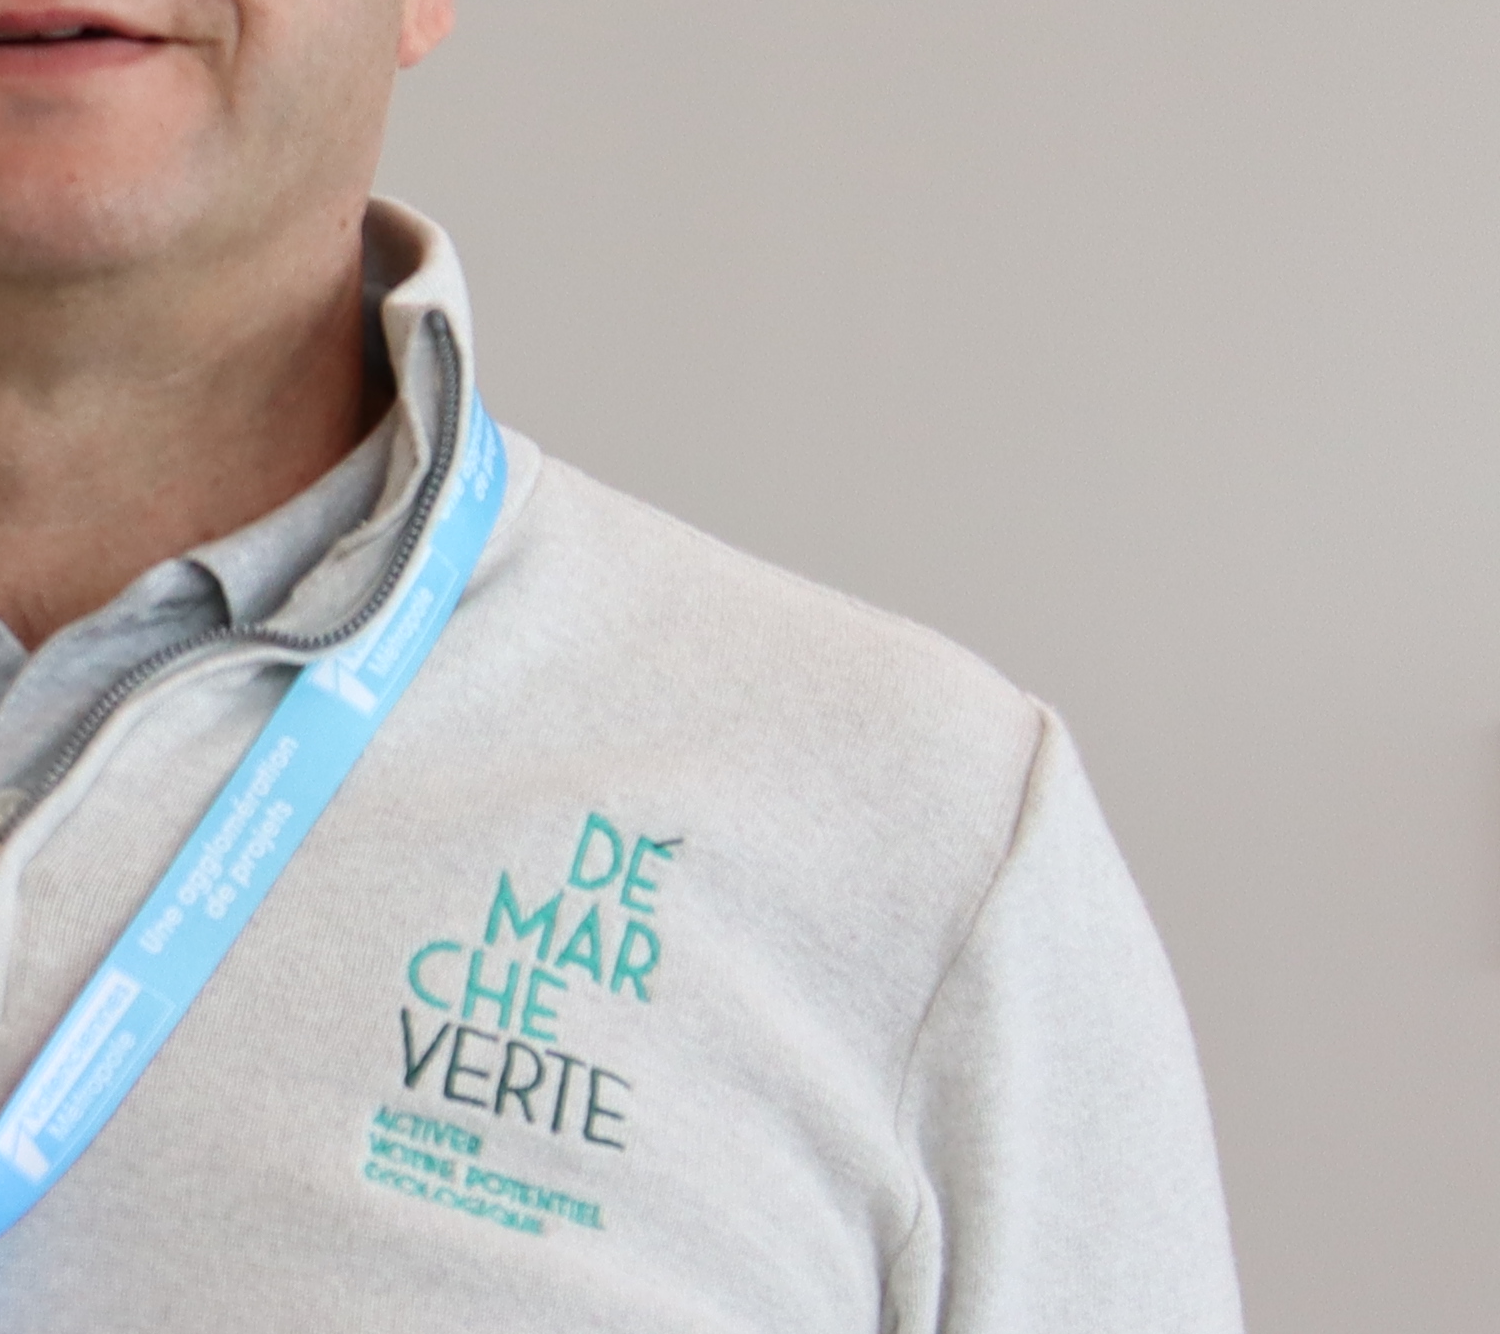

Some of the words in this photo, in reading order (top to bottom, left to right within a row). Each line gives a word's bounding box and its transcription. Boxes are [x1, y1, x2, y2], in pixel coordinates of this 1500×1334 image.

[567, 810, 685, 915] DÉ
[406, 939, 569, 1043] CHE
[484, 868, 662, 1004] MAR
[400, 1006, 633, 1152] VERTE
